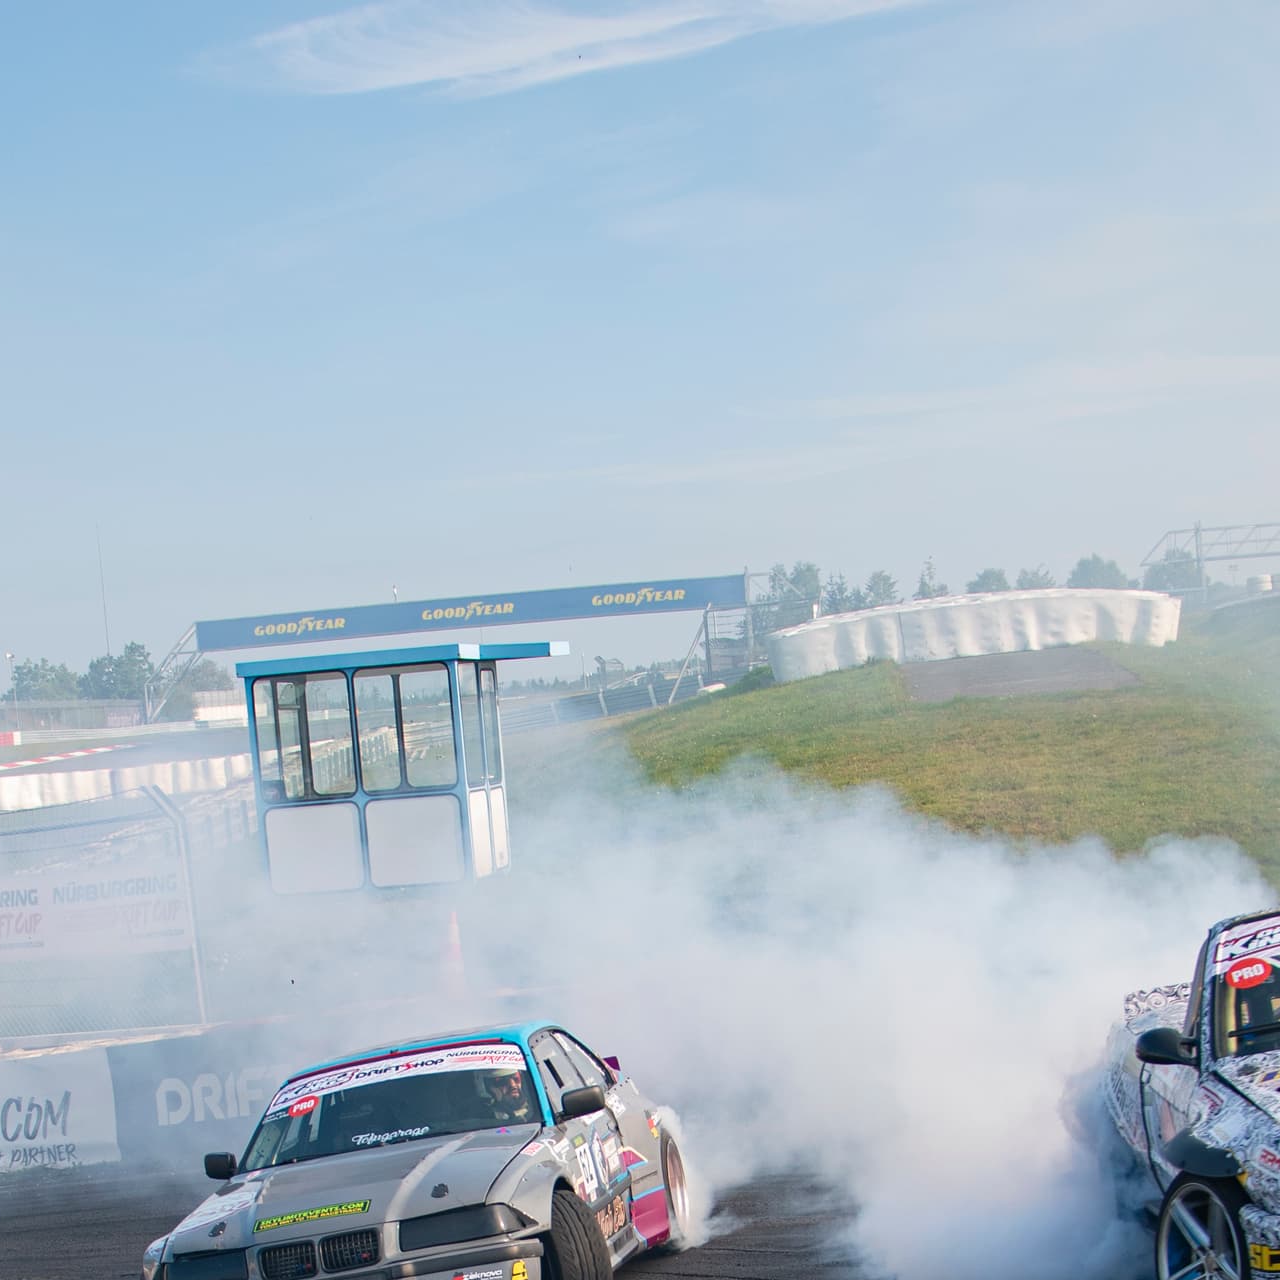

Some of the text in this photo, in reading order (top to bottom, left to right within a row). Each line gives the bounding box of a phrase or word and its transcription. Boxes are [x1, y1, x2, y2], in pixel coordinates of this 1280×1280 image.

[591, 587, 686, 606] GOODYEAR
[422, 602, 514, 621] GOODYEAR
[254, 616, 346, 636] GOODYEAR
[1231, 963, 1265, 983] PRO
[355, 1058, 444, 1080] DRIFTSHOP
[292, 1099, 315, 1113] PRO
[260, 1202, 365, 1225] SKYLIMITEVENTS.COM
